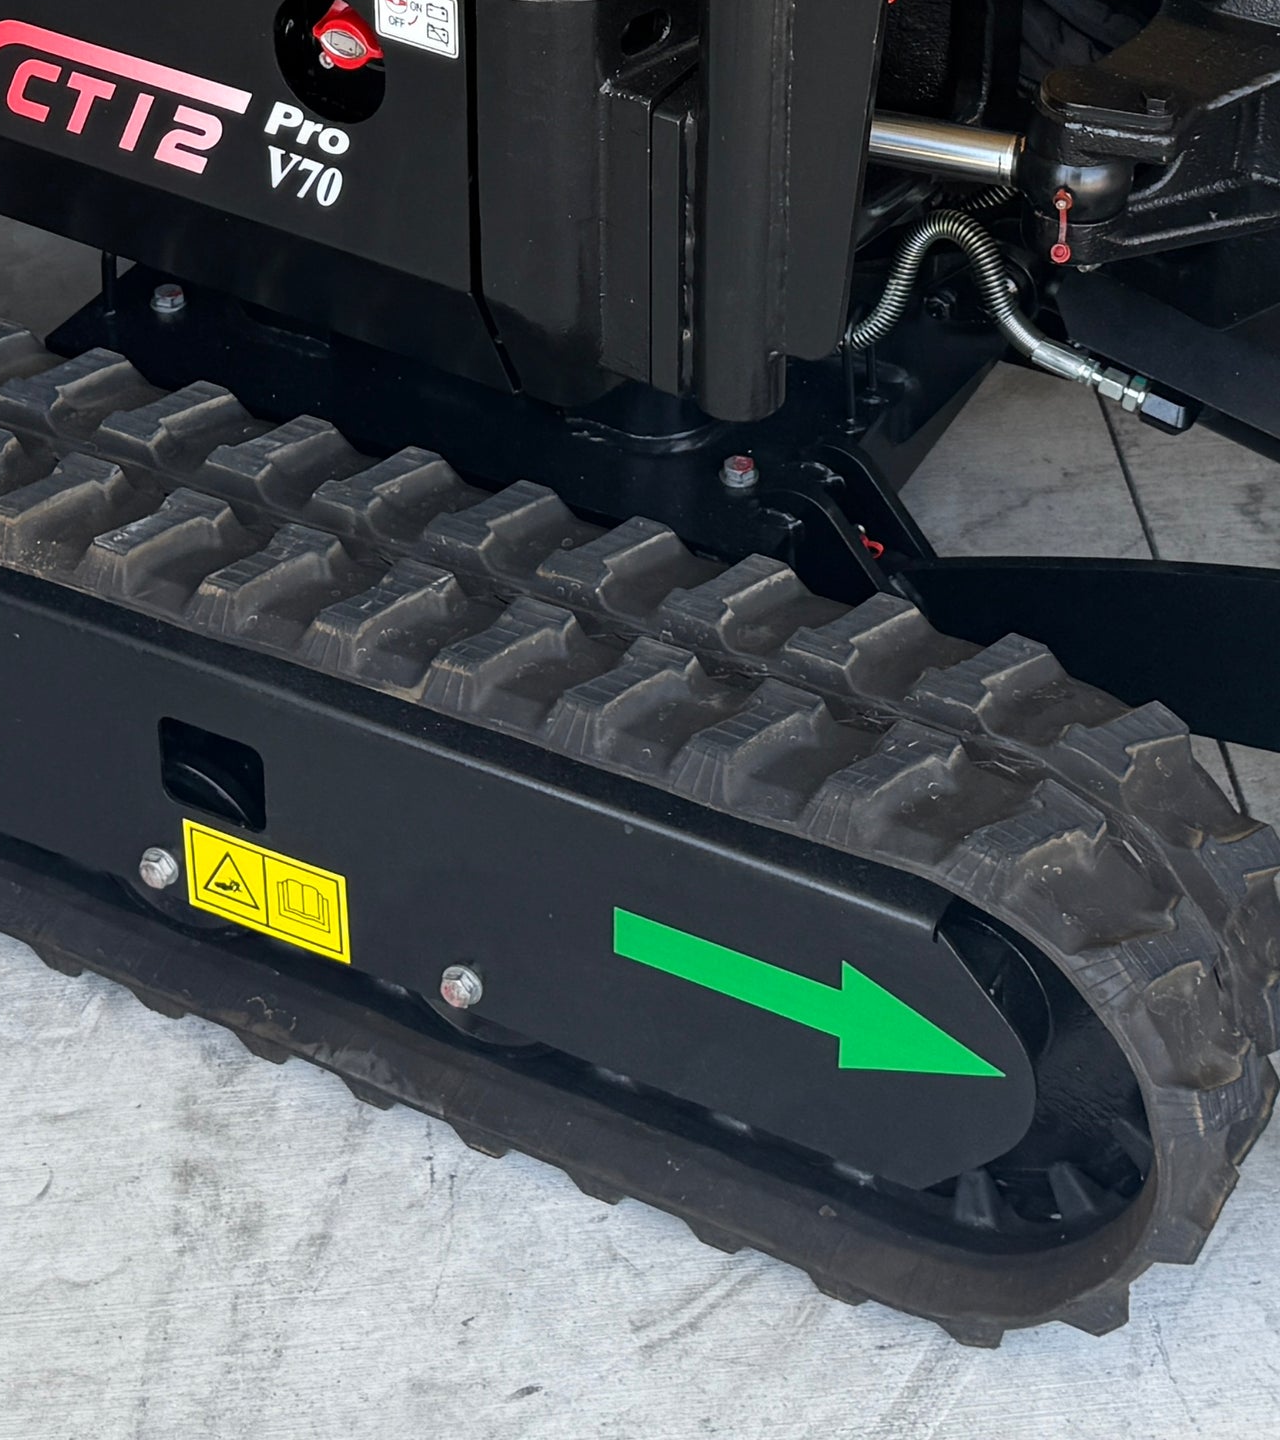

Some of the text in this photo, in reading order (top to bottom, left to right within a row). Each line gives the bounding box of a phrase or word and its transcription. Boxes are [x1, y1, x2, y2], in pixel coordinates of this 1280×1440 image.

[388, 16, 406, 28] OFF
[410, 0, 423, 13] ON
[6, 58, 351, 175] CT12 Pro
[267, 144, 344, 208] V70
